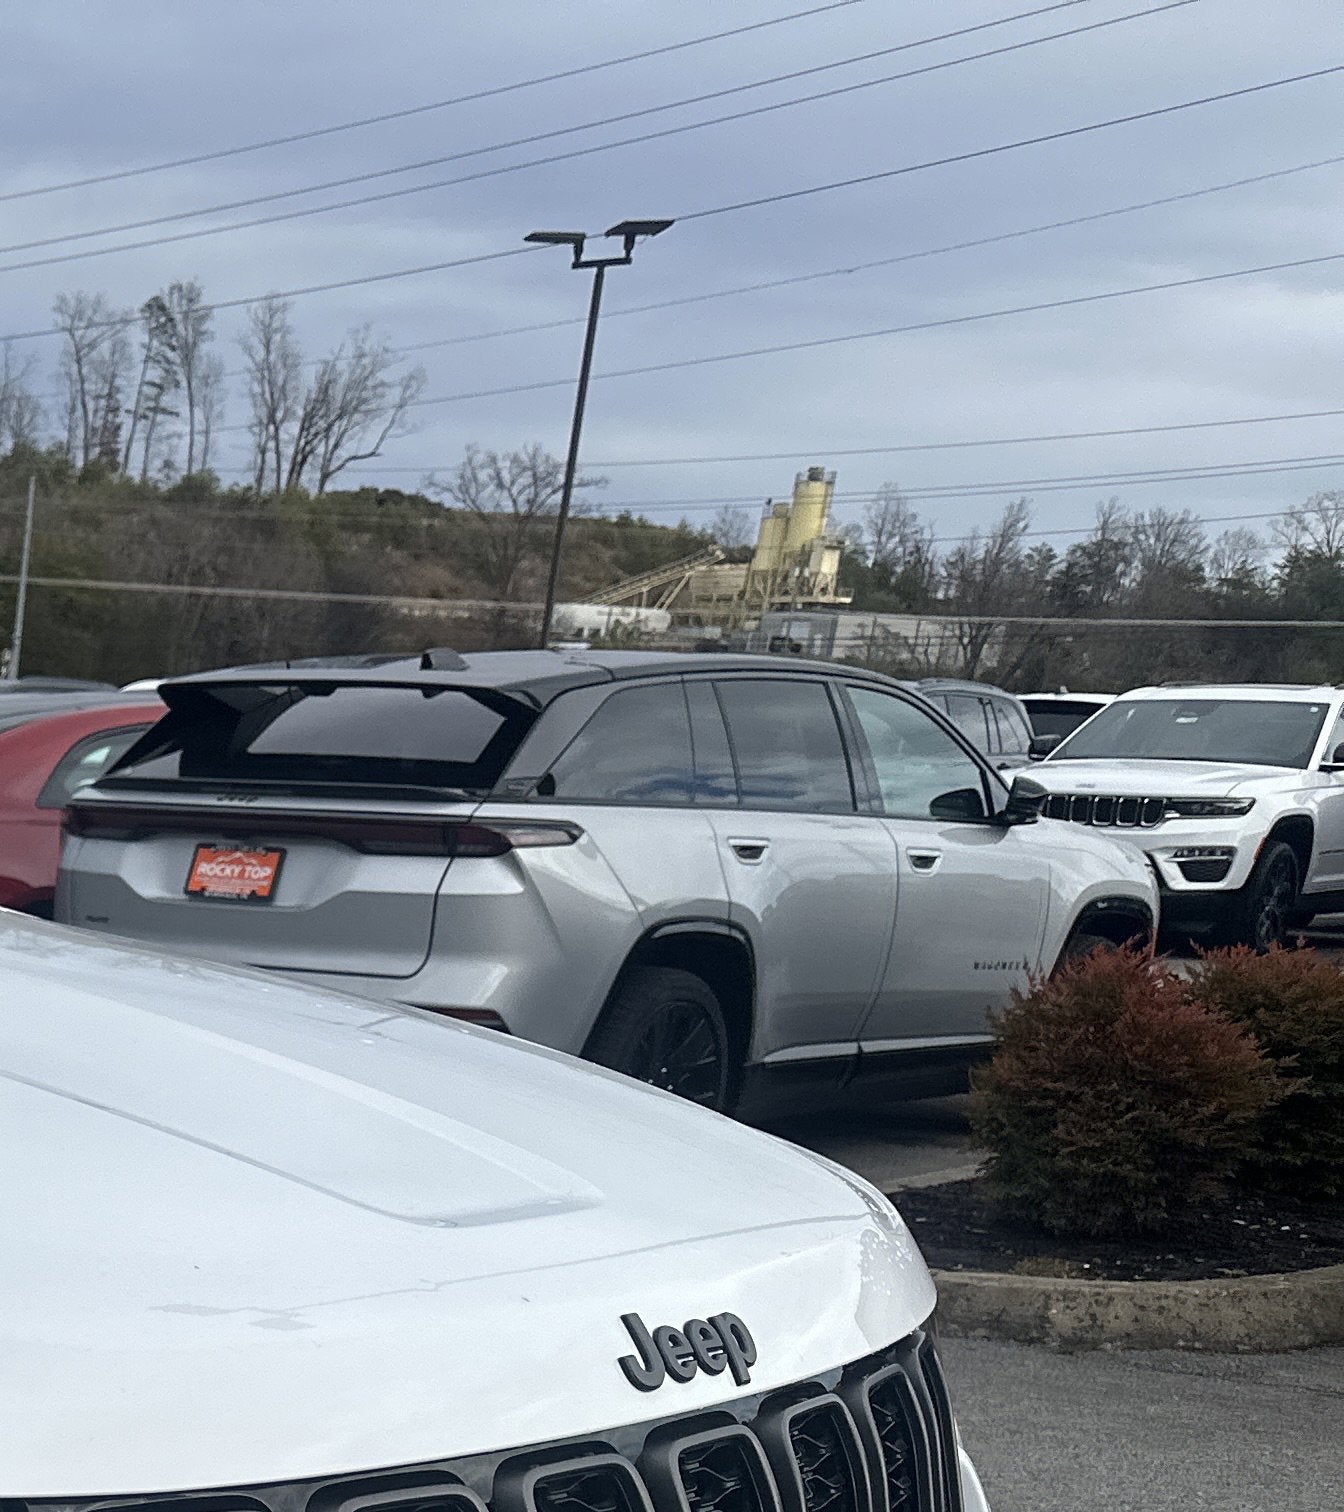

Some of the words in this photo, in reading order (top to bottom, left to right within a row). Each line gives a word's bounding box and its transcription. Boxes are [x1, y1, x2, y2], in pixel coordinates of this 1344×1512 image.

[198, 863, 242, 877] ROCKY
[244, 865, 272, 880] TOP
[618, 1312, 757, 1392] Jeep
